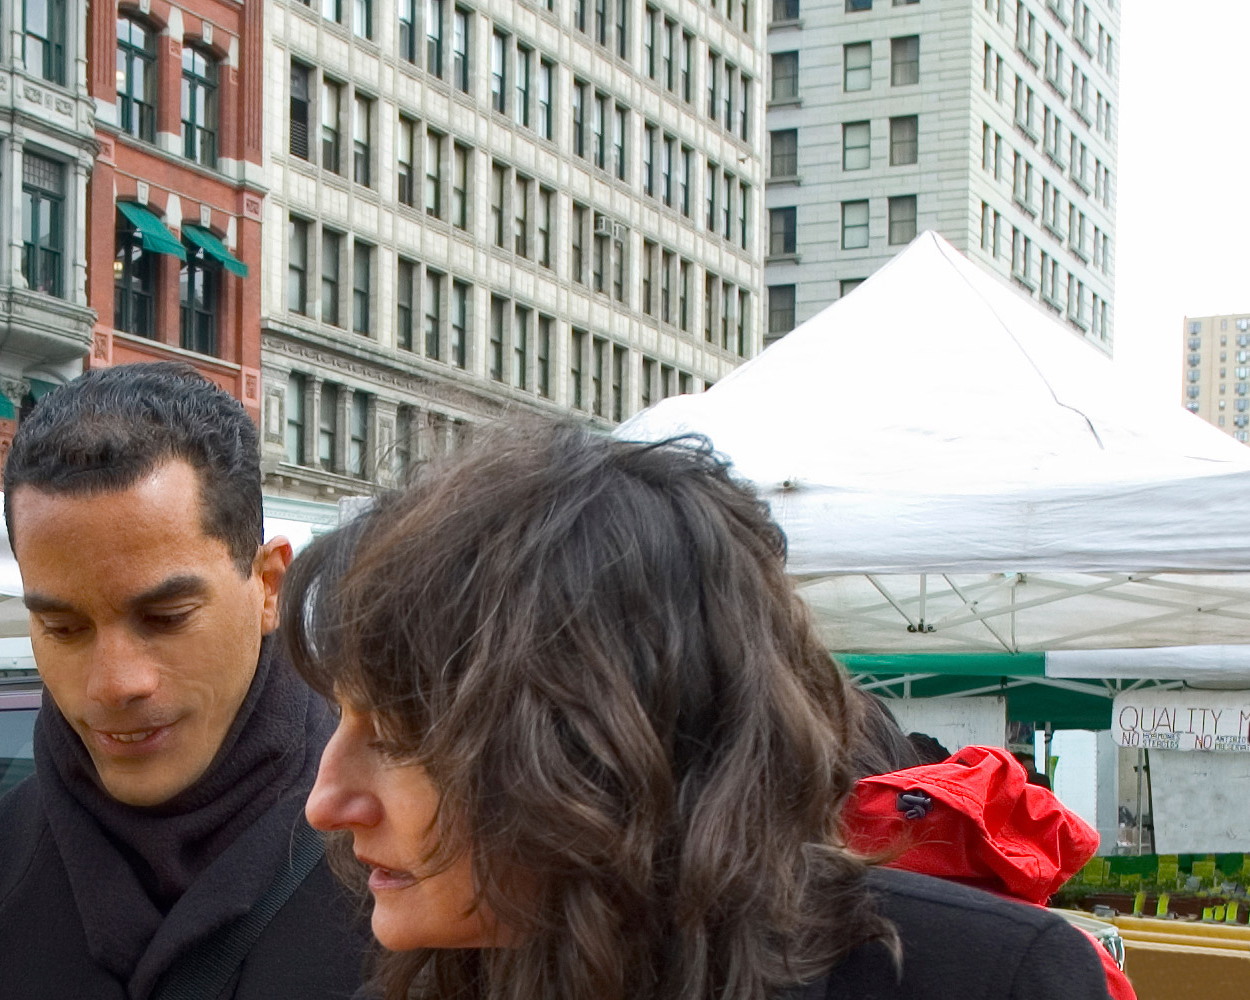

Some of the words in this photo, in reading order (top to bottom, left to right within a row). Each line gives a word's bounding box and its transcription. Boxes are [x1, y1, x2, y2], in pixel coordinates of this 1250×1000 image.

[1119, 706, 1223, 735] QUALITY
[1121, 731, 1140, 747] NO
[1194, 734, 1213, 749] NO
